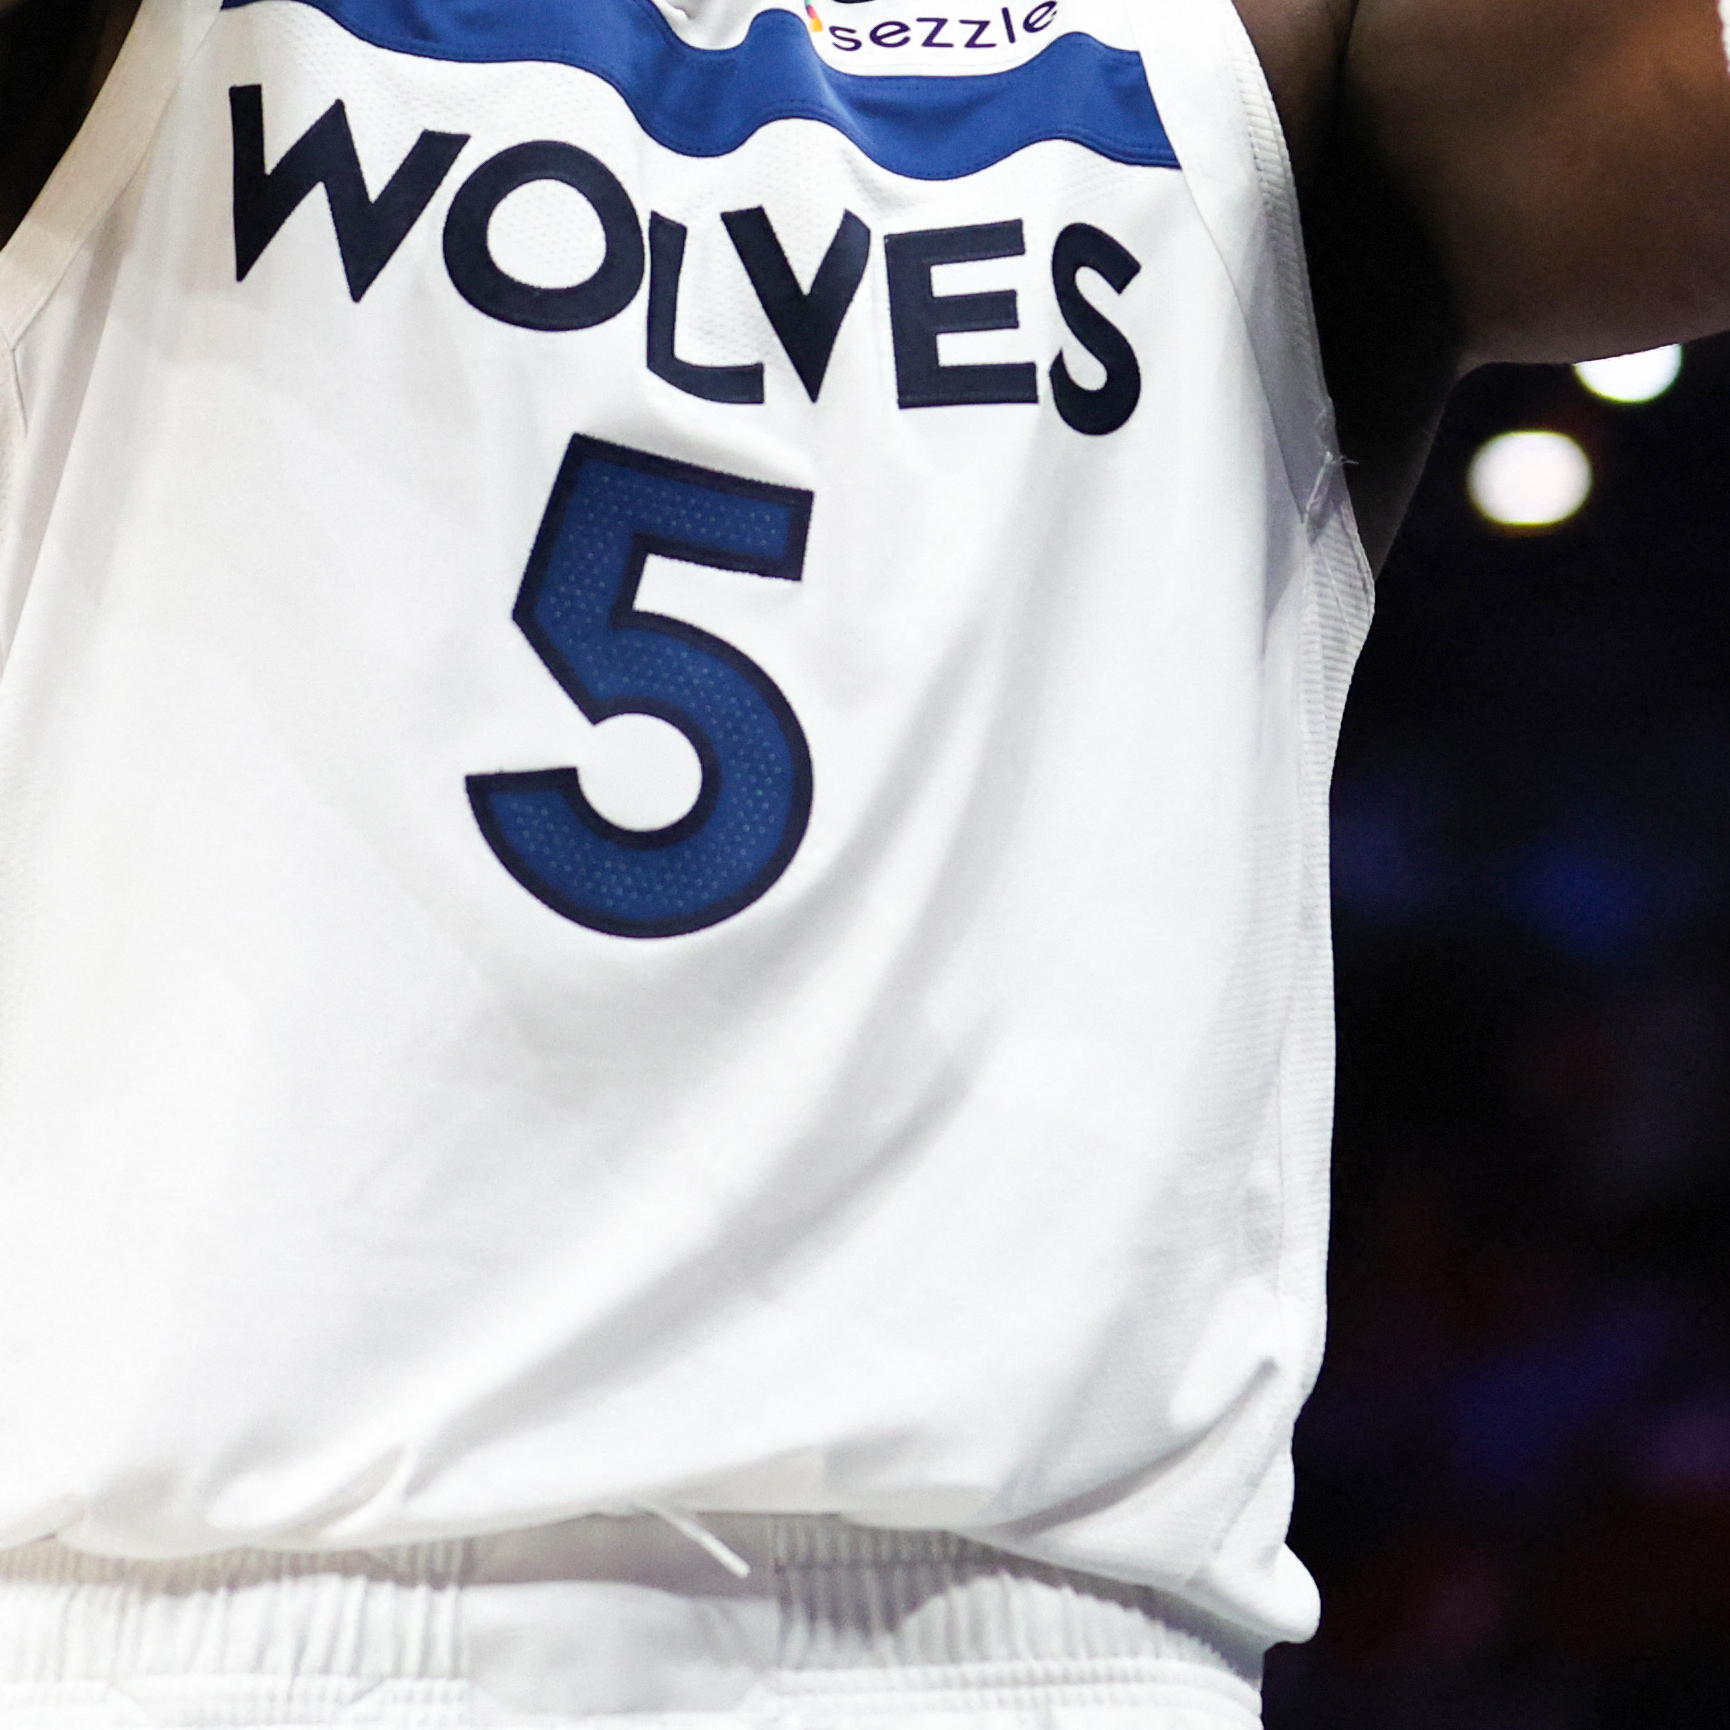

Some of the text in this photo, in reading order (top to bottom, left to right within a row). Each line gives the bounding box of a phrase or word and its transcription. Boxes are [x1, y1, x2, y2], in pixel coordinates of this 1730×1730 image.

[828, 0, 1058, 52] sezzle
[229, 84, 1142, 436] WOLVES
[465, 432, 815, 939] 5
